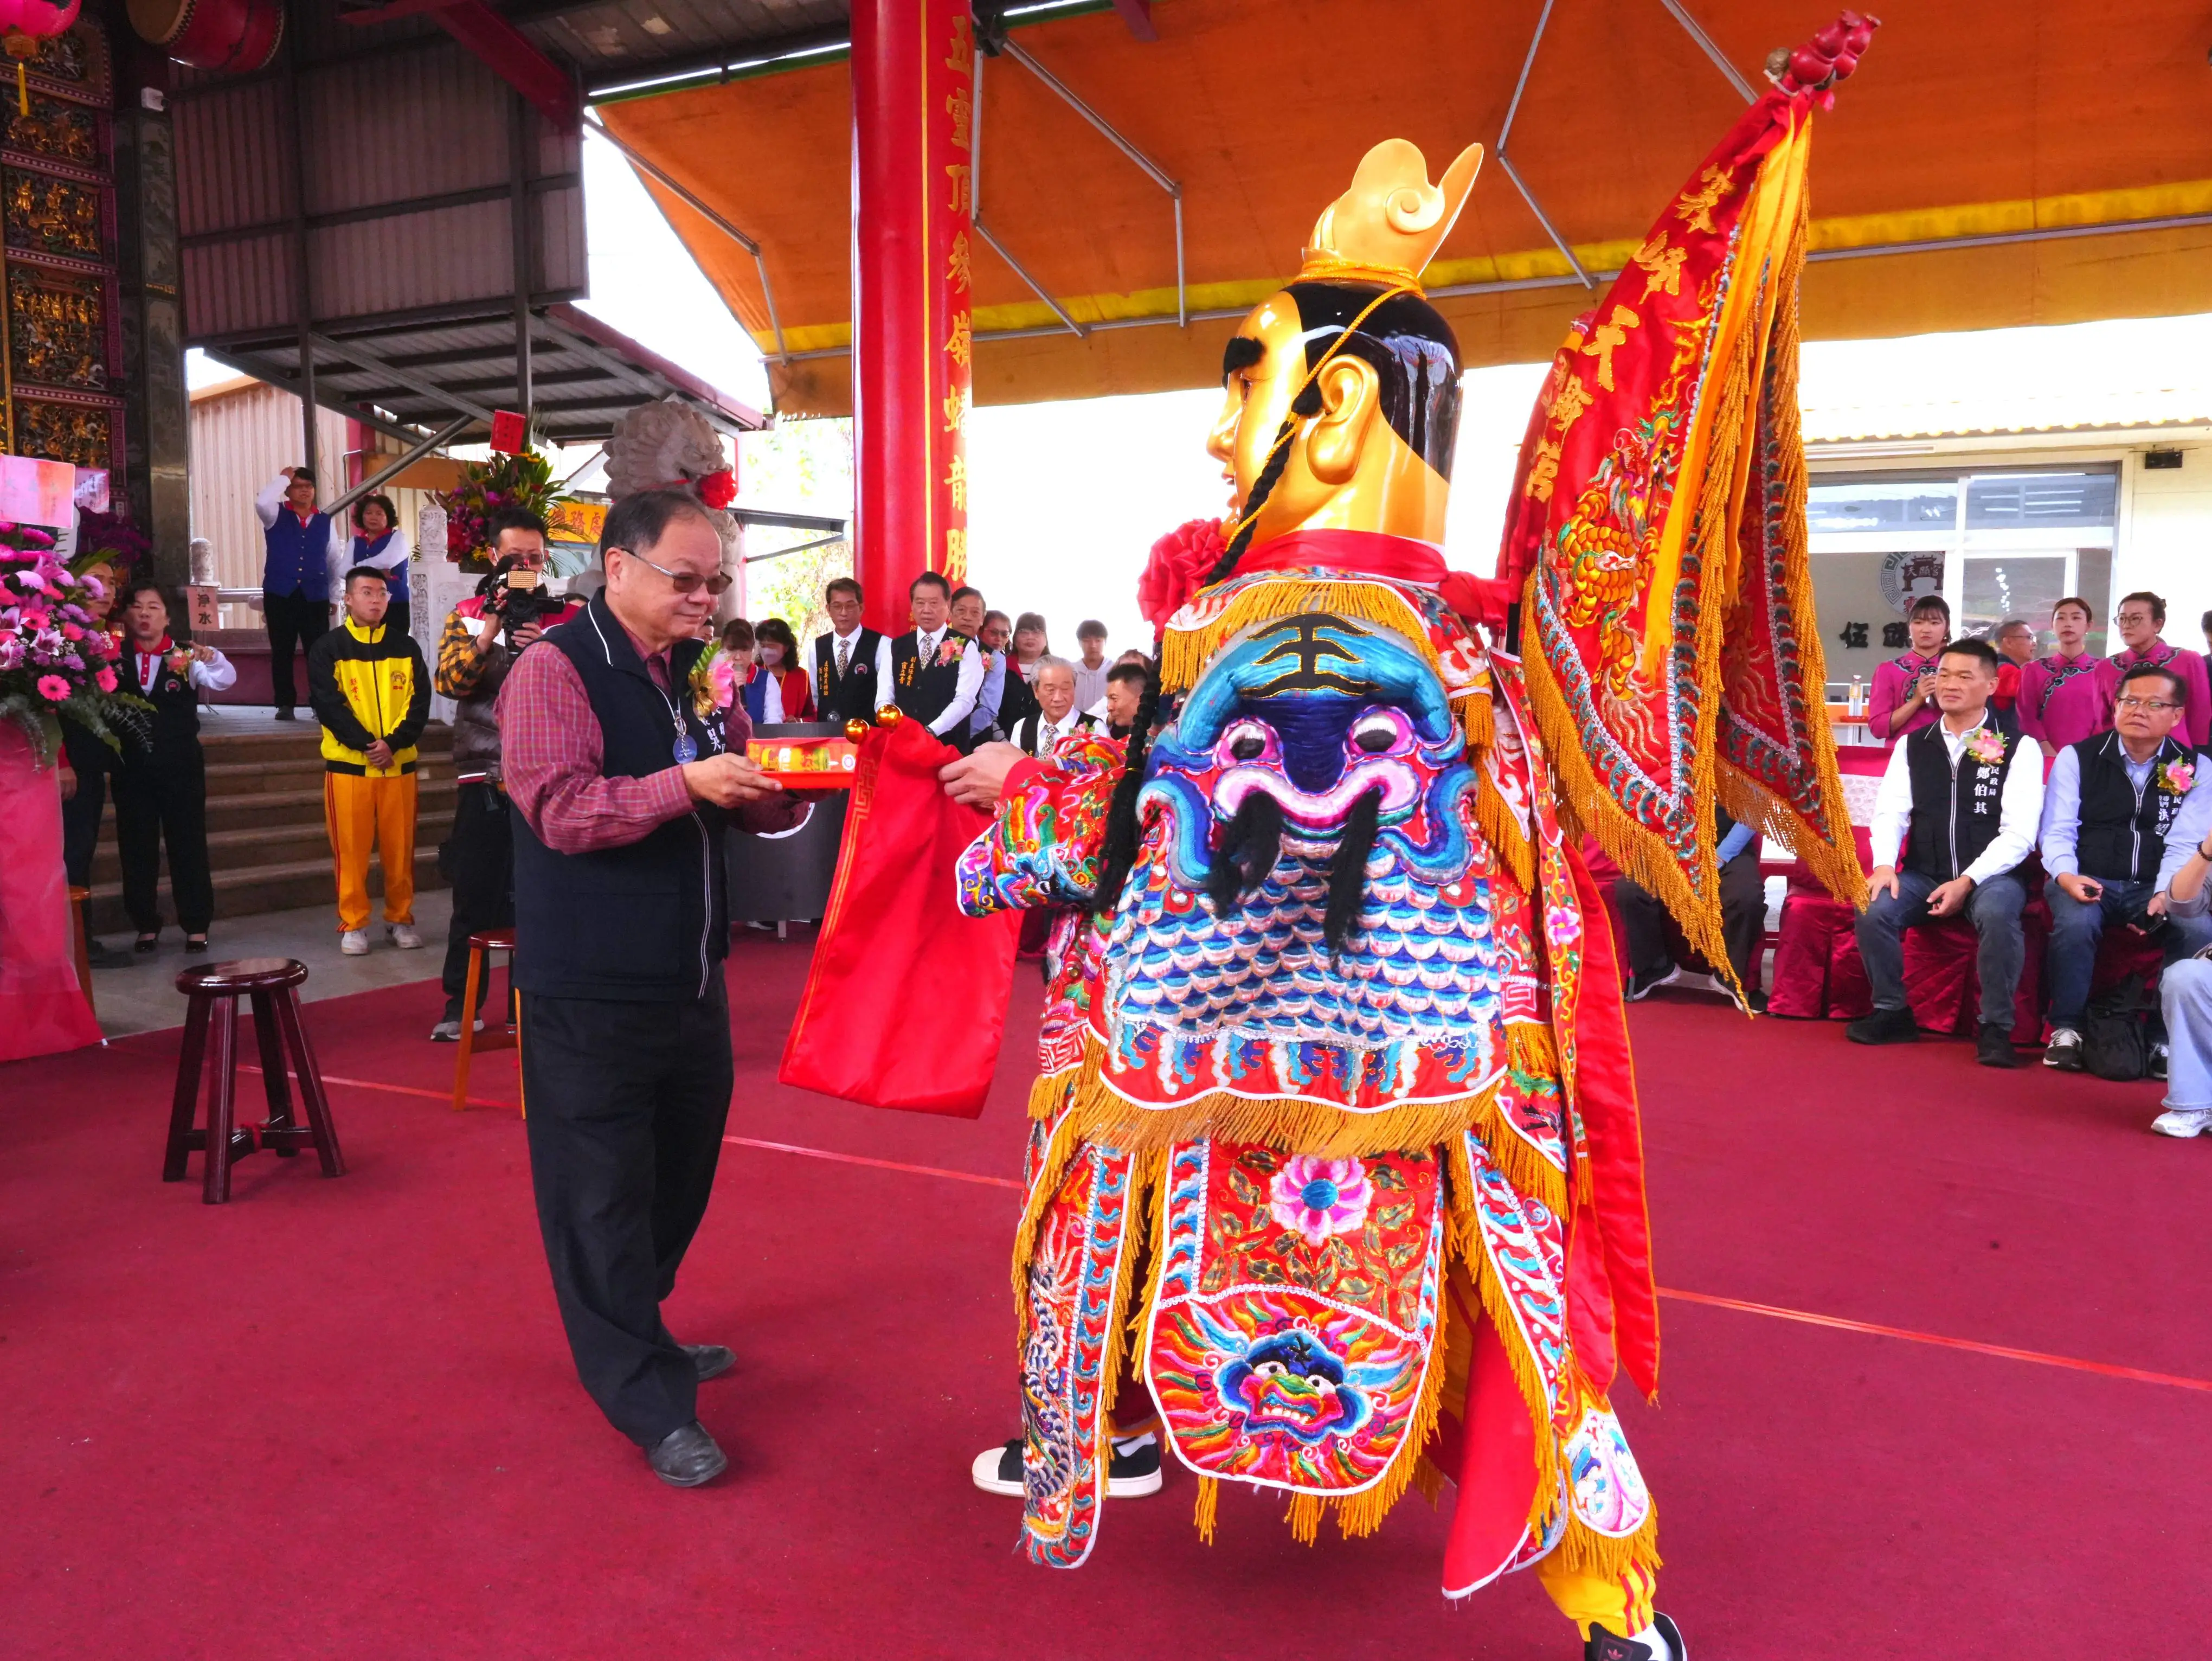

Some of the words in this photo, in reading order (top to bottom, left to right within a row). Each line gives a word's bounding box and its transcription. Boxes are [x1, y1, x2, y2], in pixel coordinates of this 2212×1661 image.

[197, 593, 212, 625] 淨水
[1973, 766, 1990, 815] 鄭伯其
[1988, 767, 1999, 796] 民政局
